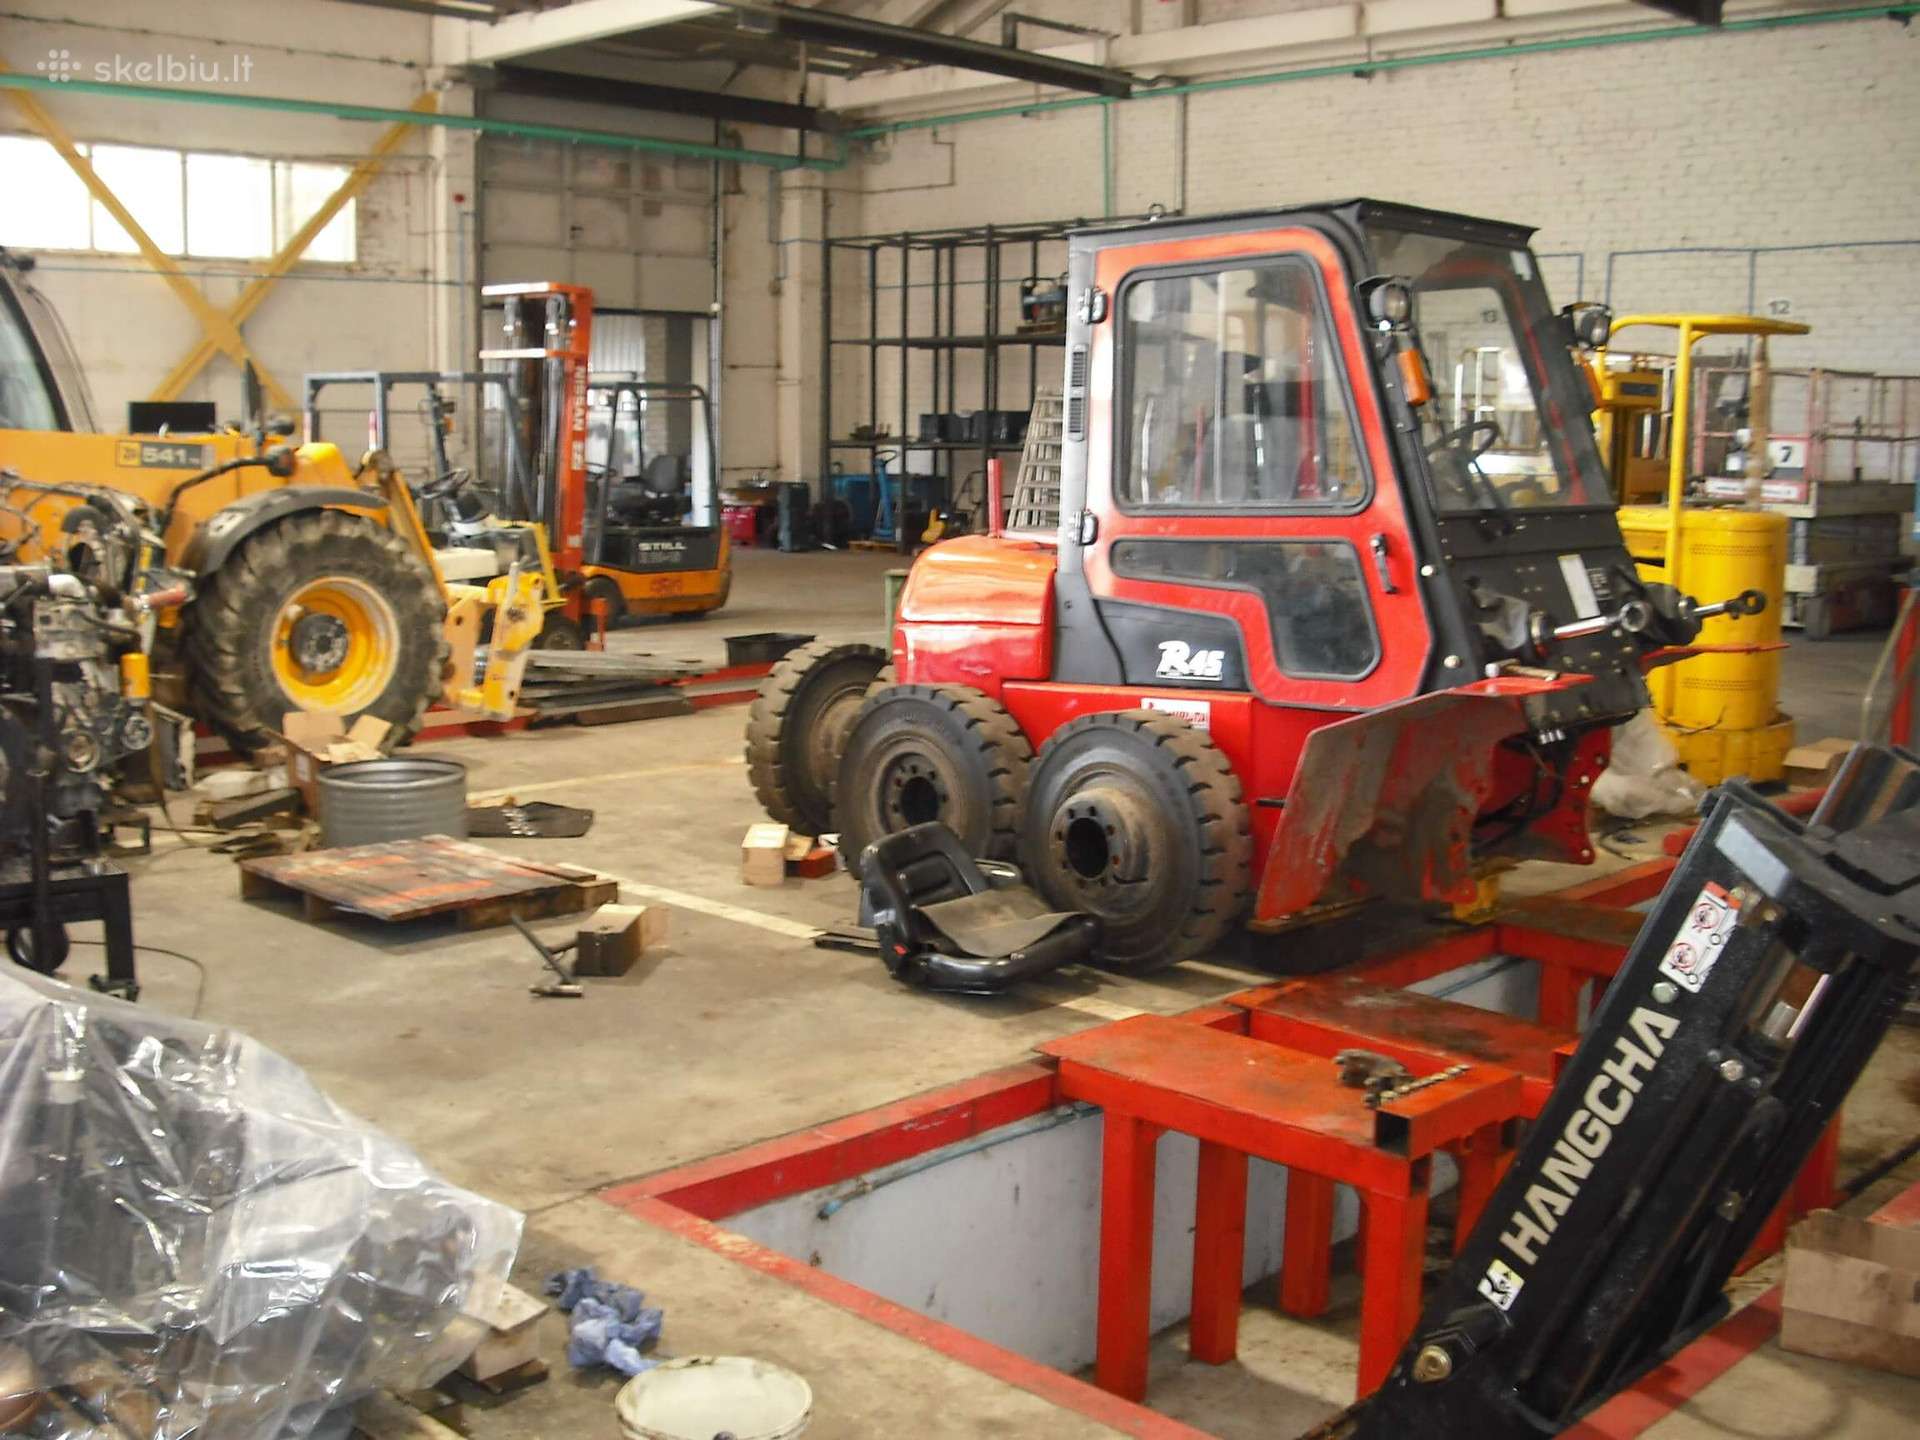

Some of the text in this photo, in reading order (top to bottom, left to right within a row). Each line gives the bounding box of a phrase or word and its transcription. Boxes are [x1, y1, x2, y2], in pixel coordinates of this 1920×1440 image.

[1768, 300, 1791, 315] 12
[1781, 445, 1793, 463] 7
[1499, 1006, 1681, 1266] HANGCHA
